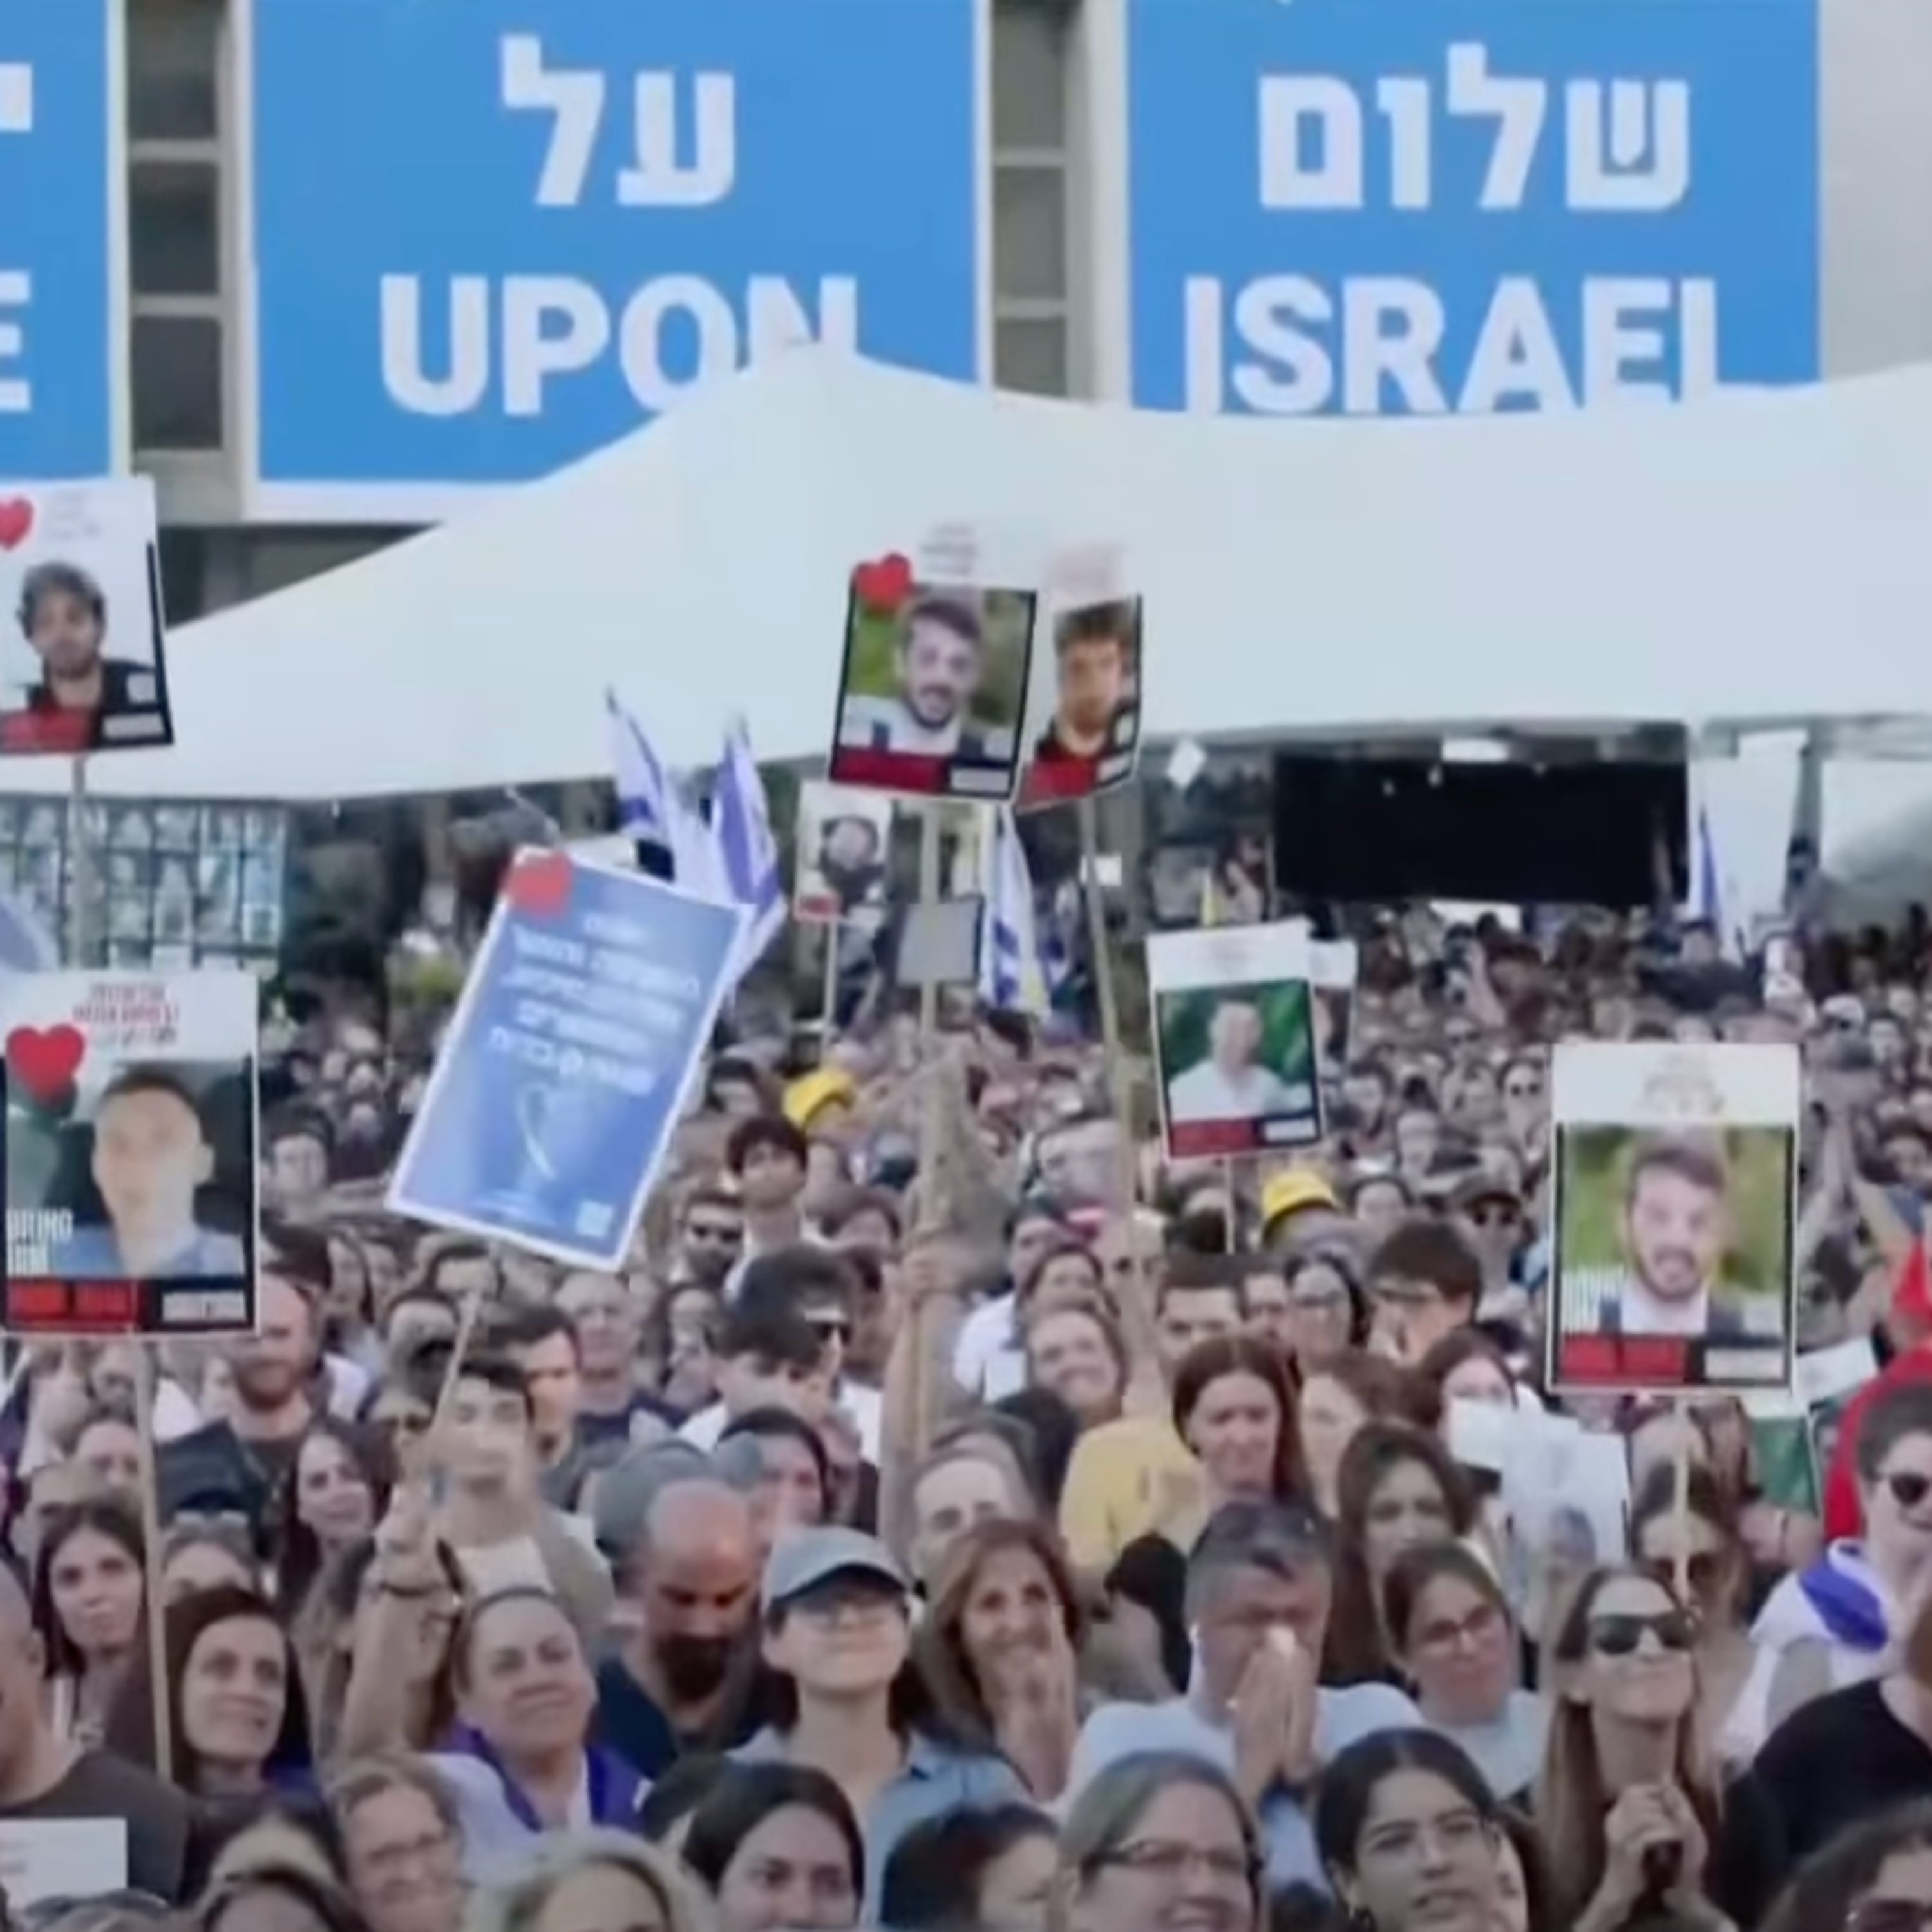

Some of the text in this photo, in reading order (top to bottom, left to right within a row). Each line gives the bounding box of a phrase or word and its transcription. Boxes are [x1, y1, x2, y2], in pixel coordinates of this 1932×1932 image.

[502, 35, 735, 205] על
[1258, 43, 1689, 209] שלום
[381, 274, 857, 415] UPON
